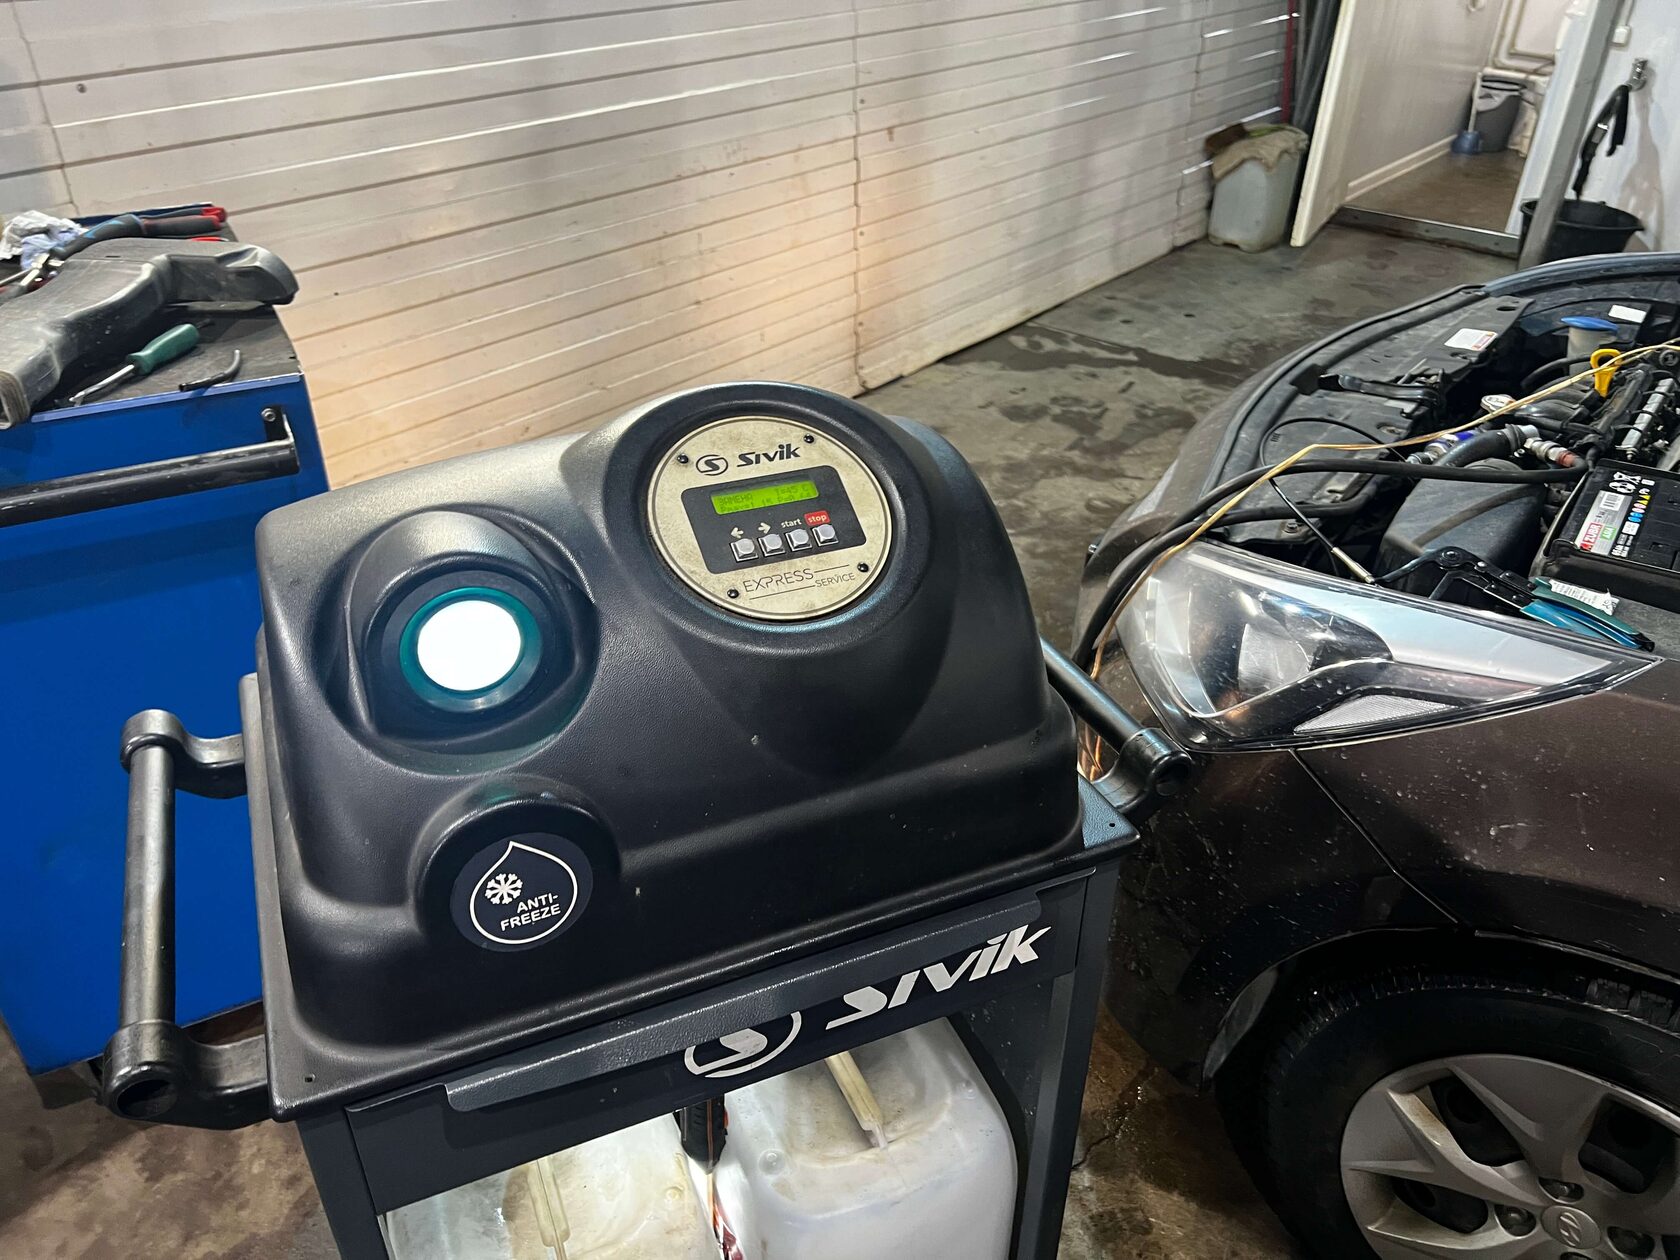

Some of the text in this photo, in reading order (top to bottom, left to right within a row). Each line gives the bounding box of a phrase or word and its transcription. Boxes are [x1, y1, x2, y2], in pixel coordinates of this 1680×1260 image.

[780, 518, 802, 528] start
[807, 514, 827, 523] stop
[742, 568, 856, 592] EXPRESS SERVICE
[517, 893, 558, 914] ANTI-
[500, 904, 561, 931] FREEZE
